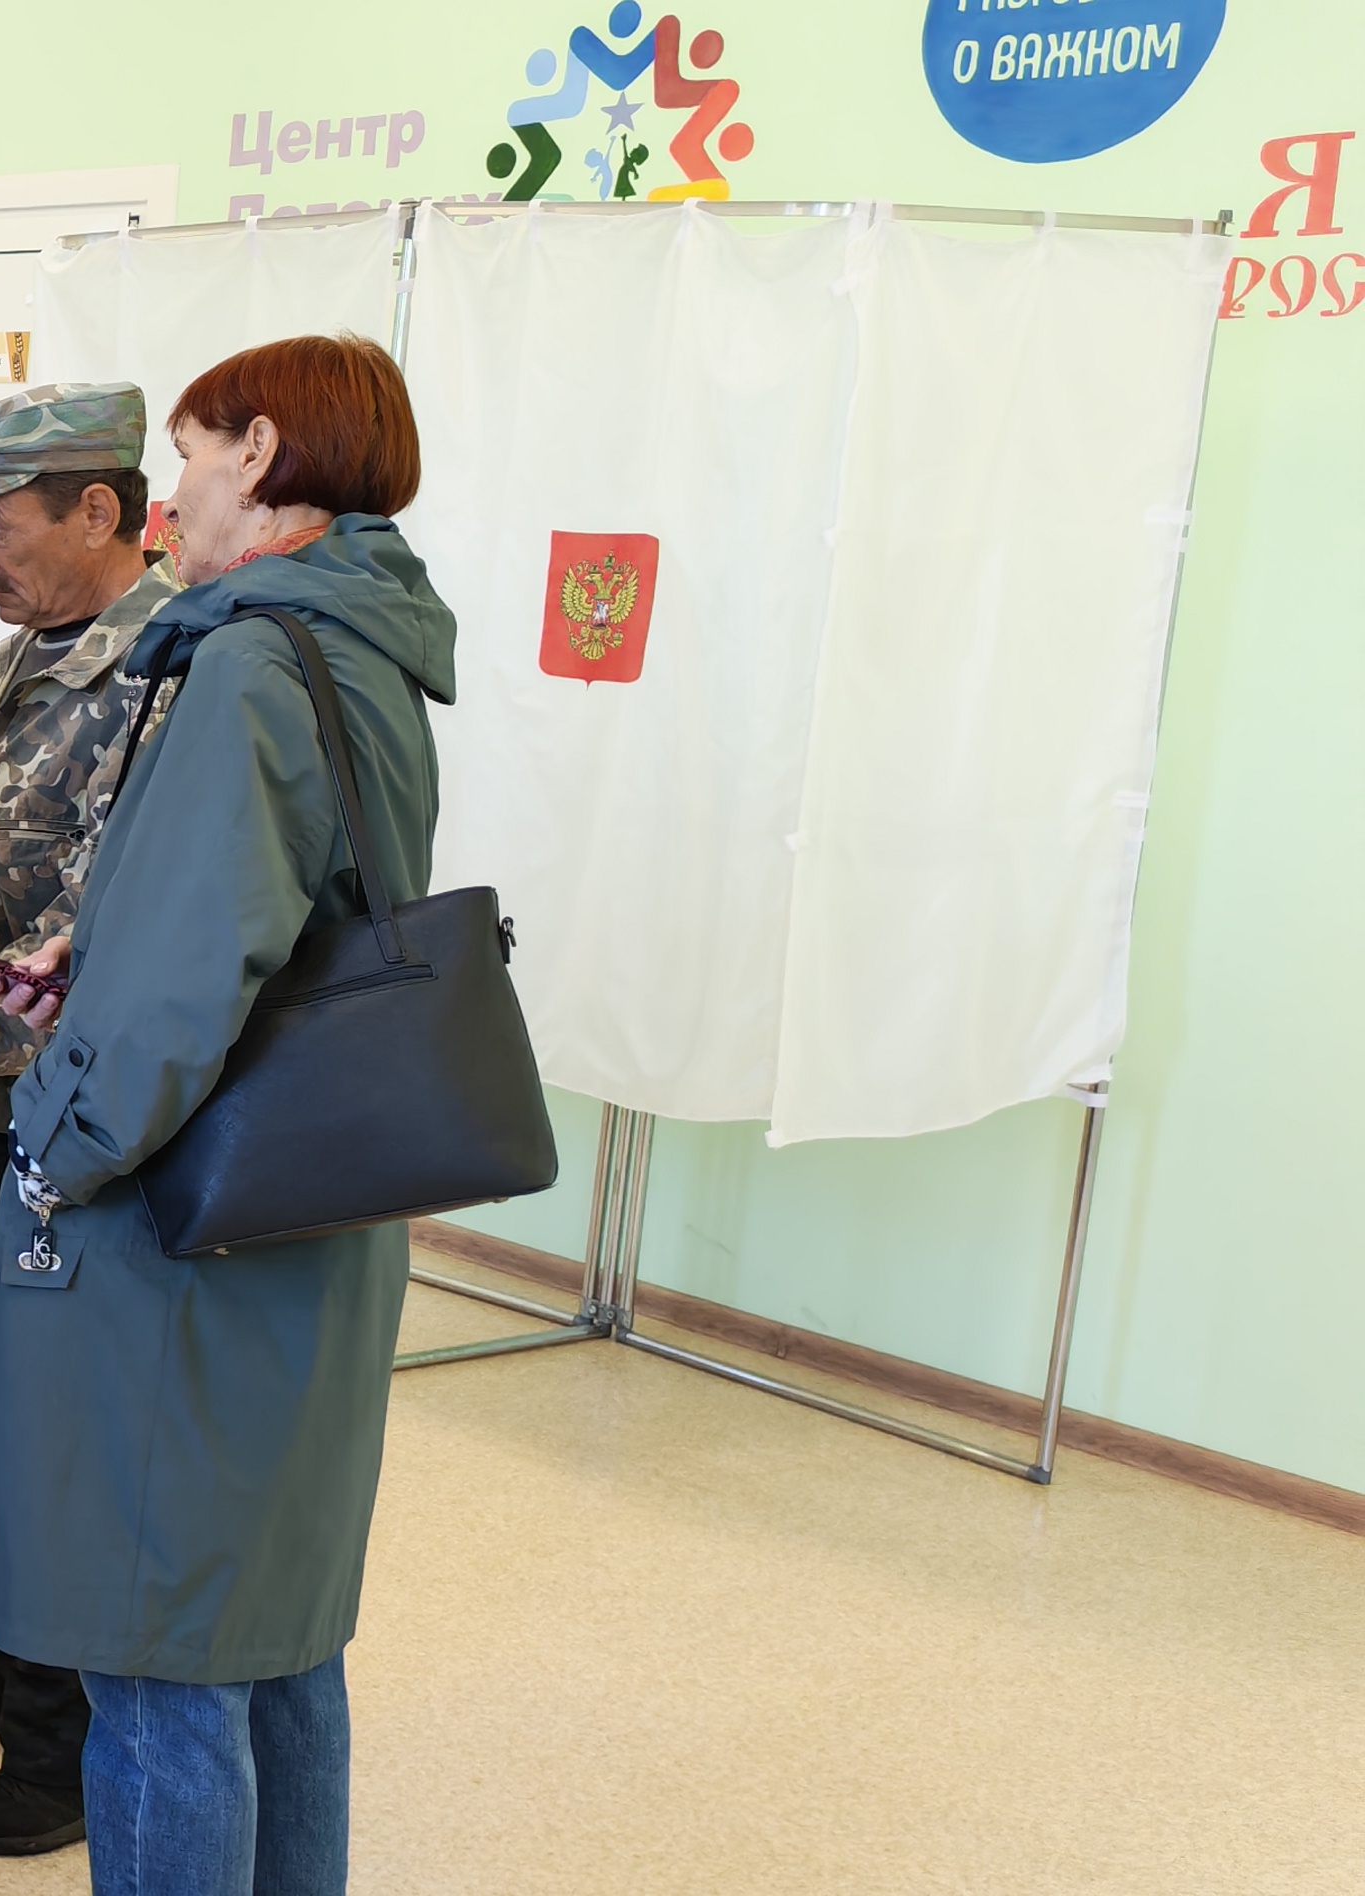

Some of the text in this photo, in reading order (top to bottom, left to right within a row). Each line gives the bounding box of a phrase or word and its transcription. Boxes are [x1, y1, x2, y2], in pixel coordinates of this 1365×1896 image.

[953, 22, 1181, 83] О ВАЖНОМ
[229, 110, 425, 175] Центр
[1240, 131, 1356, 238] Я
